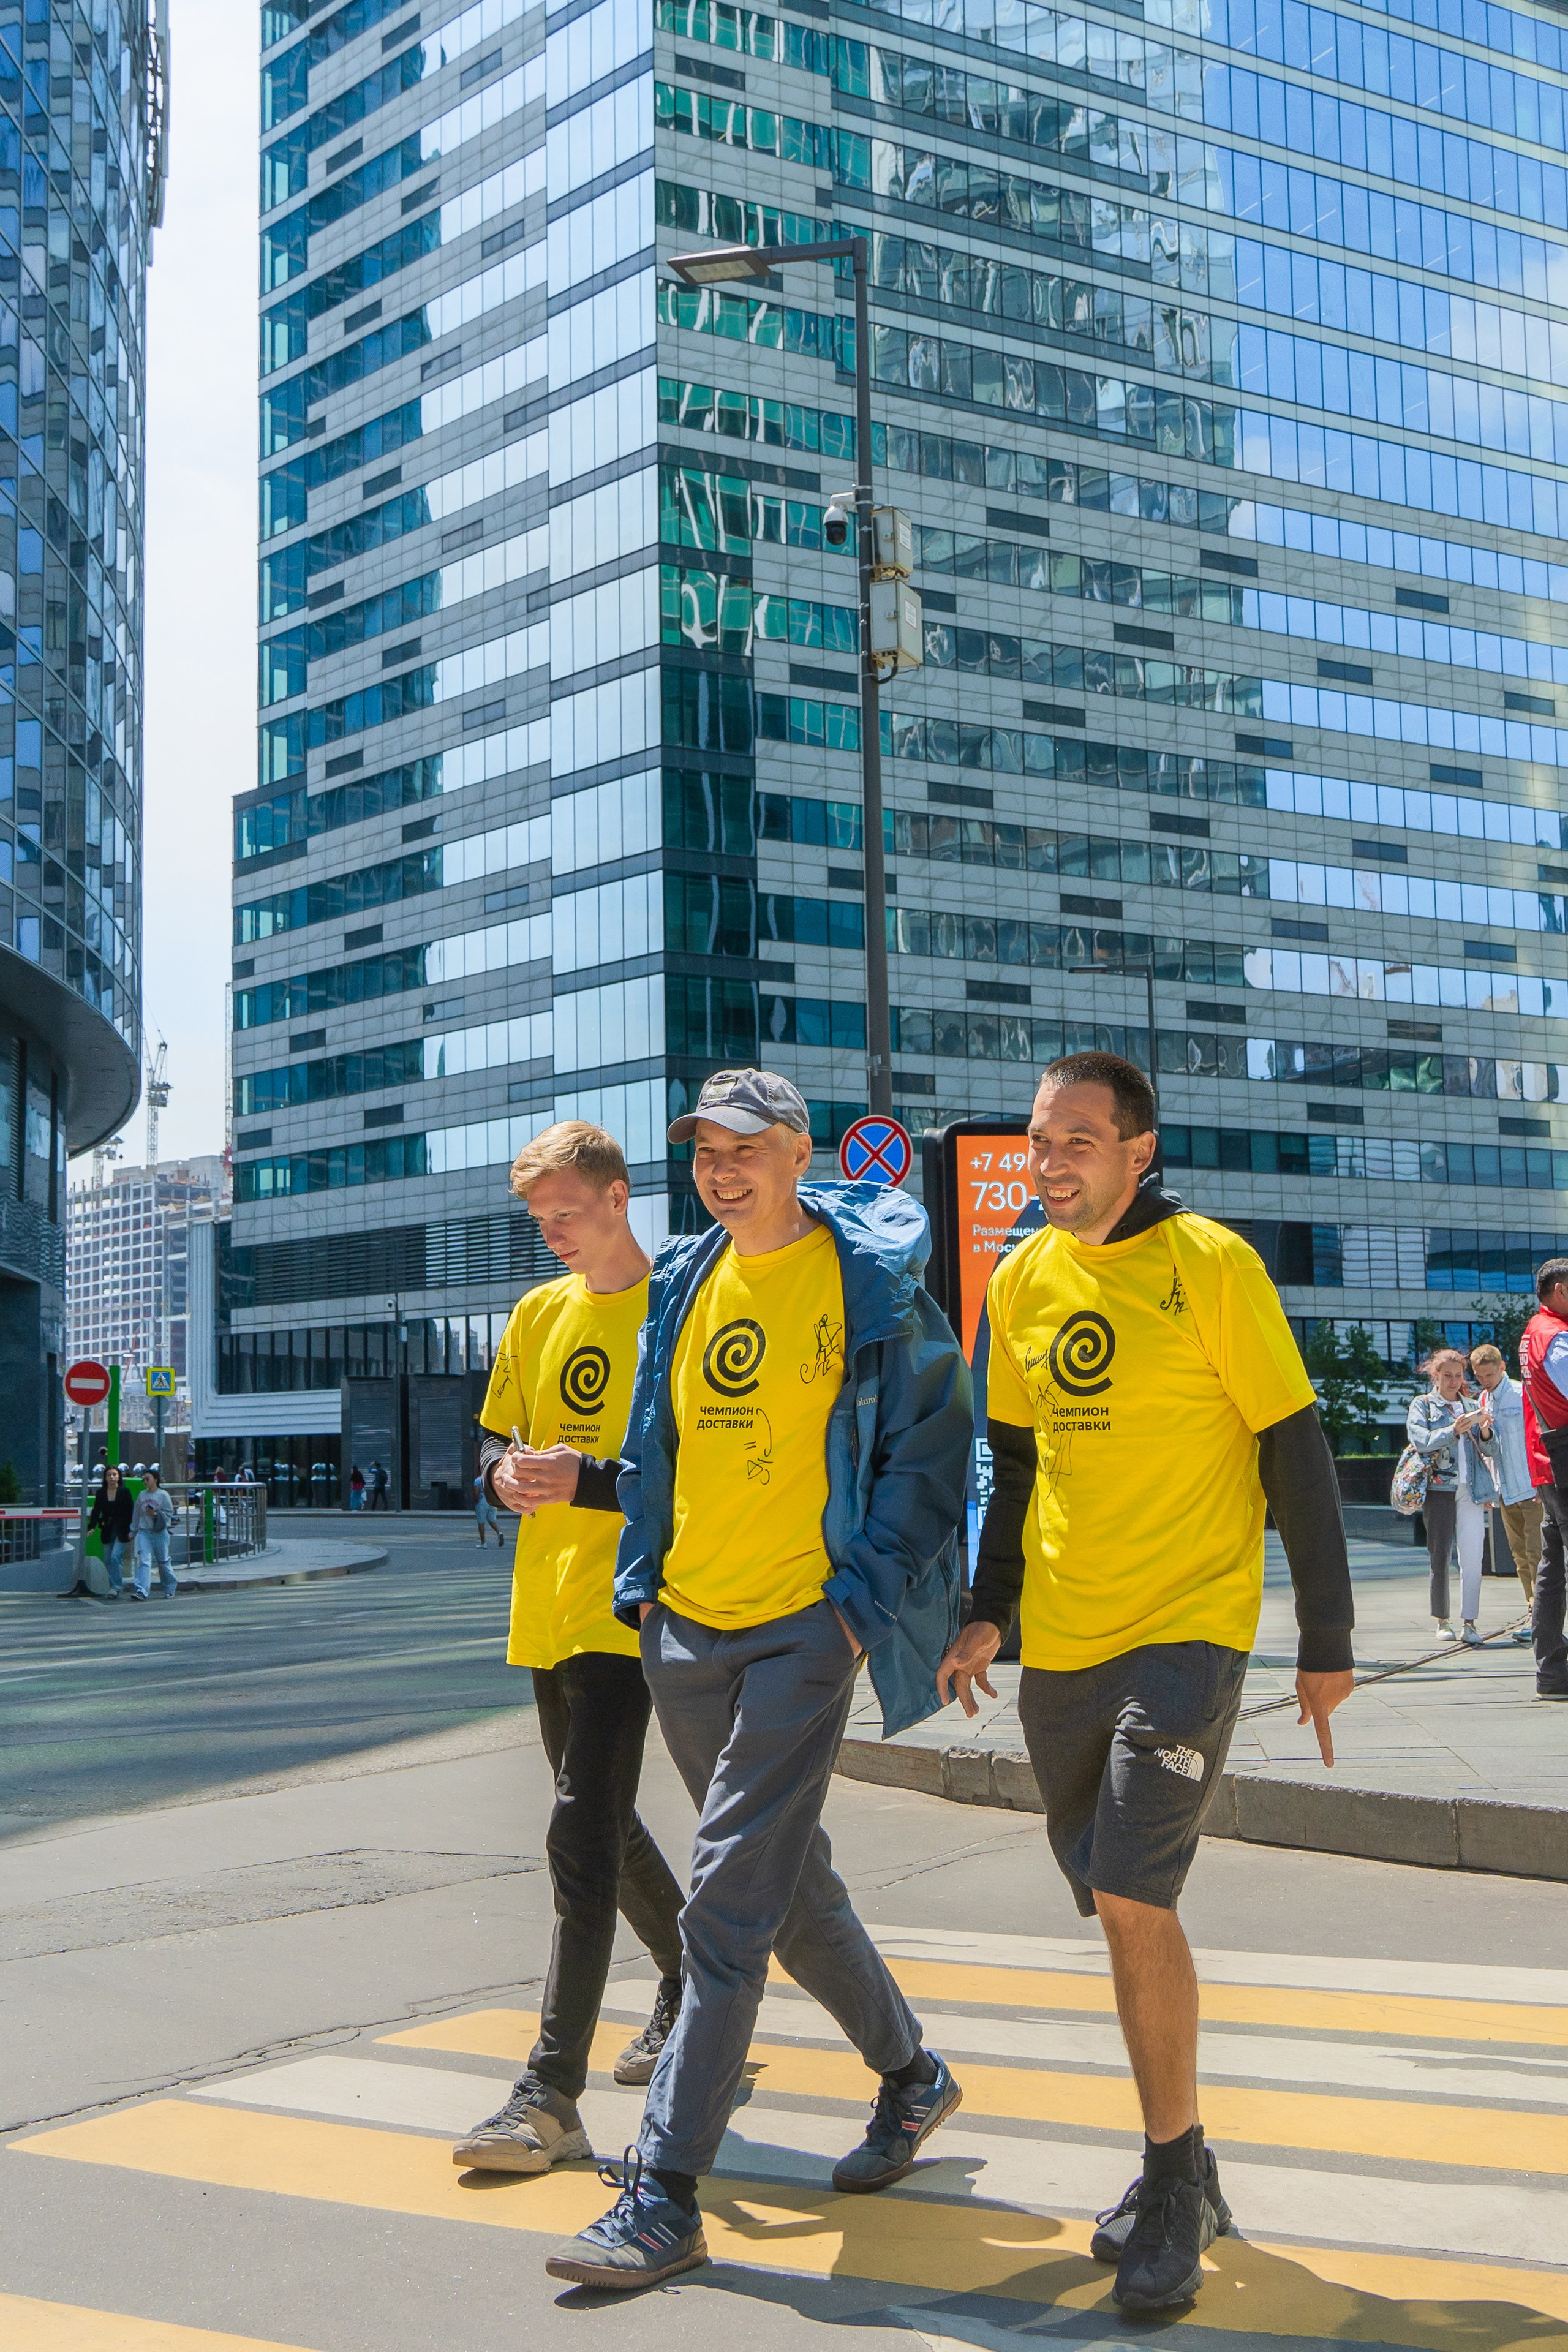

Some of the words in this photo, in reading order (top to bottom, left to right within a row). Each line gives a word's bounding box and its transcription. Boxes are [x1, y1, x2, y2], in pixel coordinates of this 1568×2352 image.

[970, 1152, 993, 1172] +7
[998, 1152, 1028, 1172] 49
[971, 1181, 1044, 1211] 730-
[973, 1244, 981, 1253] в
[700, 1406, 754, 1416] чемпион
[1053, 1406, 1109, 1417] чемпион
[560, 1423, 600, 1432] чемпион
[697, 1419, 753, 1430] доставки
[1053, 1420, 1111, 1433] доставки
[557, 1434, 600, 1444] доставки
[1154, 1747, 1192, 1767] NORTH
[1174, 1744, 1196, 1758] THE
[1161, 1758, 1189, 1776] FACE
